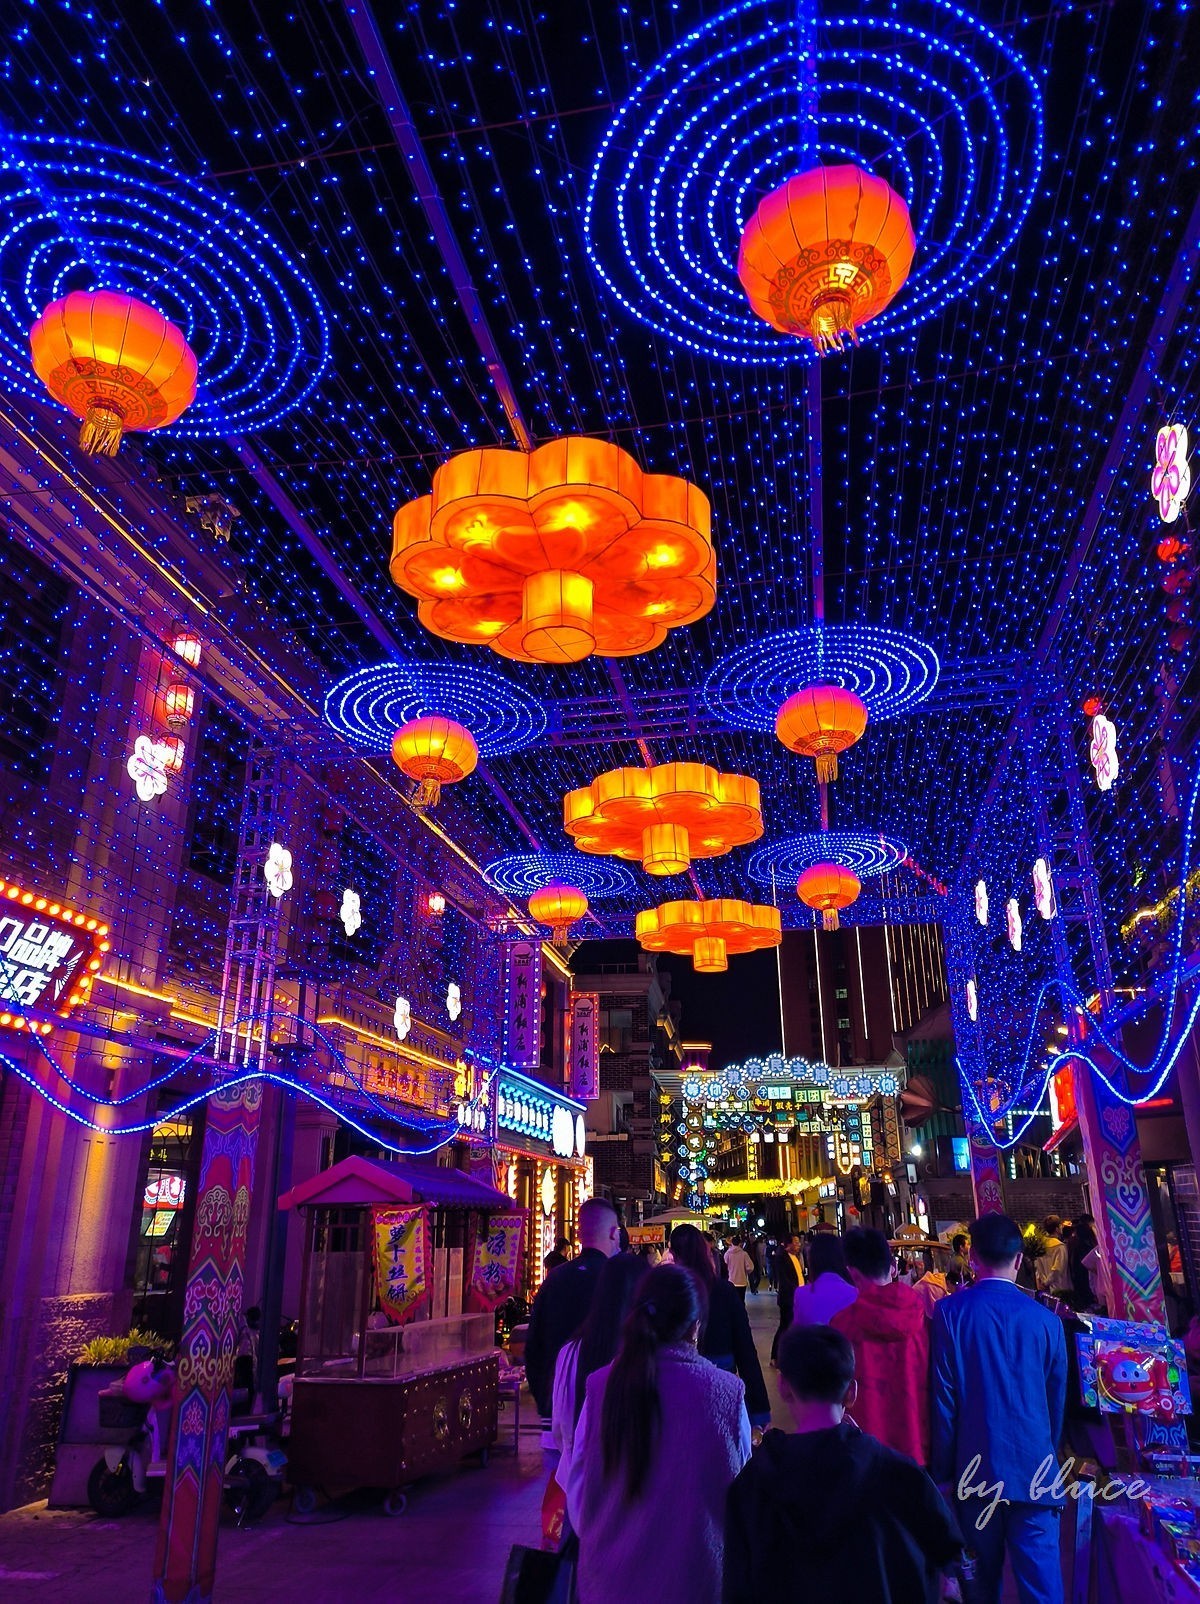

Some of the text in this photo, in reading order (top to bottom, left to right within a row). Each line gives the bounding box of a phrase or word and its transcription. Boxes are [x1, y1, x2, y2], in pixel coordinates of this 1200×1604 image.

[513, 971, 528, 1051] 新浦饭店
[577, 1022, 590, 1086] 新浦饭店
[386, 1224, 408, 1301] 萝卜丝饼
[484, 1231, 506, 1284] 凉粉
